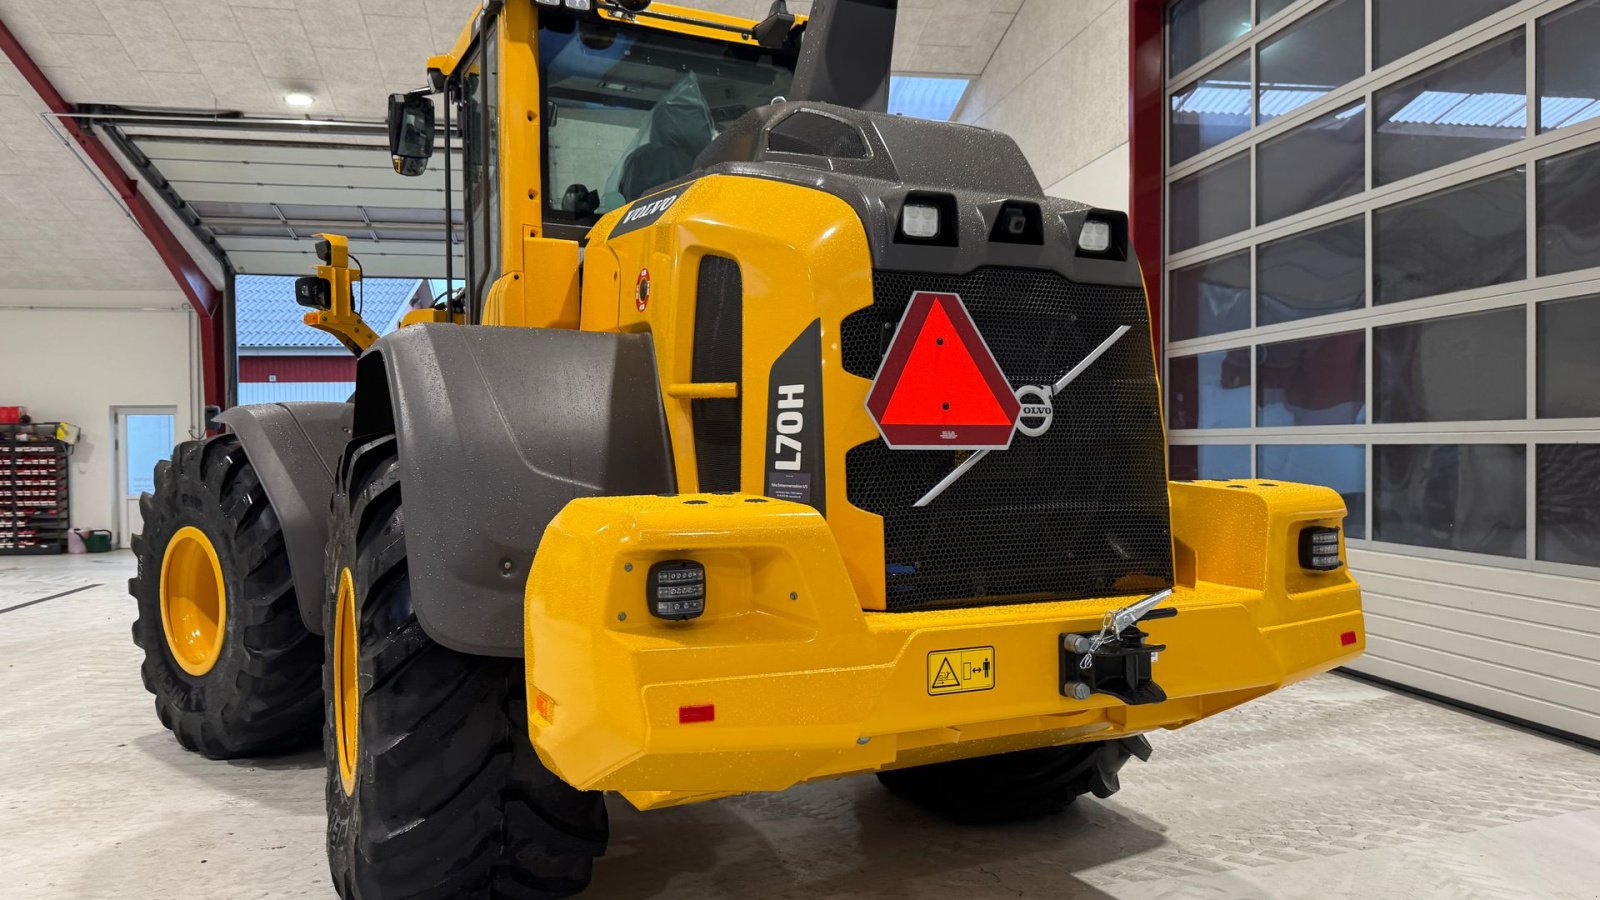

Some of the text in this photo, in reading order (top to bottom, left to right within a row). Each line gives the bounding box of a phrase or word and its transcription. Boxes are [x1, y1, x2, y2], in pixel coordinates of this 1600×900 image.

[623, 195, 677, 224] VOLVO
[1023, 406, 1052, 415] OLVO
[775, 384, 805, 471] L70H
